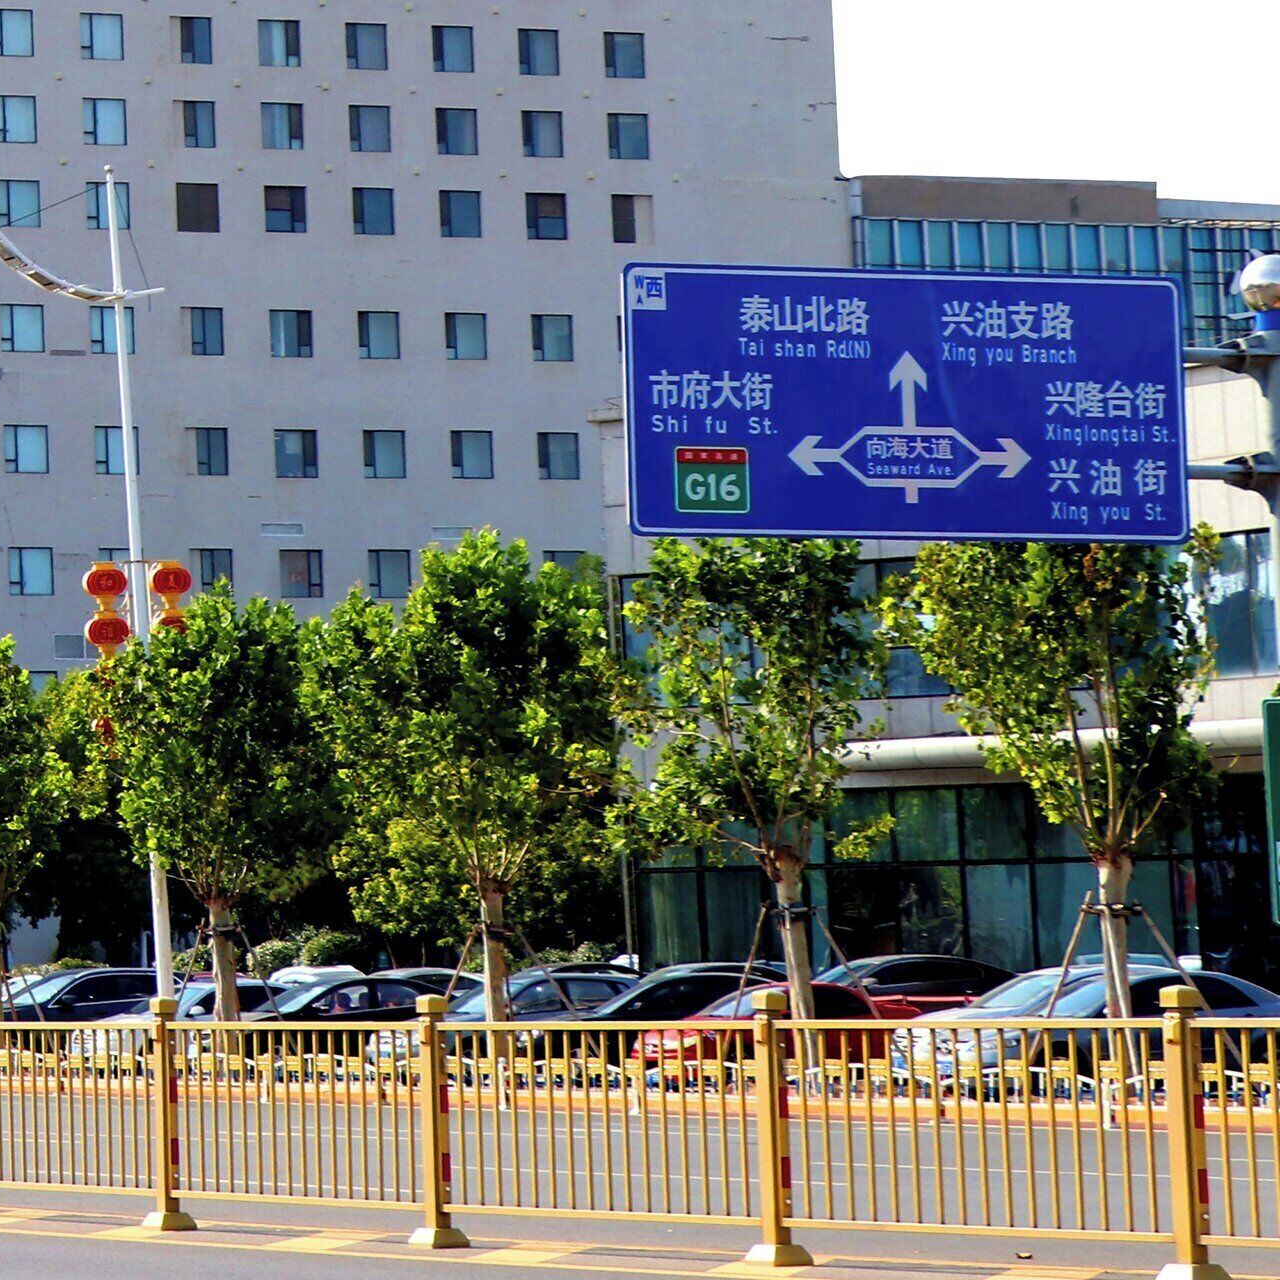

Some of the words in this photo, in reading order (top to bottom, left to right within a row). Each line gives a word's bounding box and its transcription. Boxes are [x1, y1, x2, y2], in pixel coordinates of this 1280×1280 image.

[645, 276, 663, 299] 西
[739, 294, 870, 336] 泰山北路
[941, 299, 1075, 341] 兴油支路
[739, 338, 765, 357] Tai
[774, 340, 816, 358] shan
[941, 342, 976, 367] Xing
[986, 348, 1014, 366] you
[1022, 344, 1077, 364] Branch
[649, 369, 774, 411] 市府大街
[1045, 380, 1167, 420] 兴隆台街
[651, 415, 688, 433] Shi
[705, 416, 728, 434] fu
[748, 417, 778, 434] St.
[1045, 423, 1146, 447] Xinglongtai
[1152, 426, 1177, 443] St.
[866, 436, 954, 460] 向海大道
[867, 463, 921, 475] Seaward
[928, 464, 954, 476] Ave.
[1048, 457, 1167, 496] 兴油街
[684, 473, 741, 501] G16
[1050, 501, 1088, 526] Xing
[1099, 506, 1130, 525] you
[1145, 503, 1167, 521] St.
